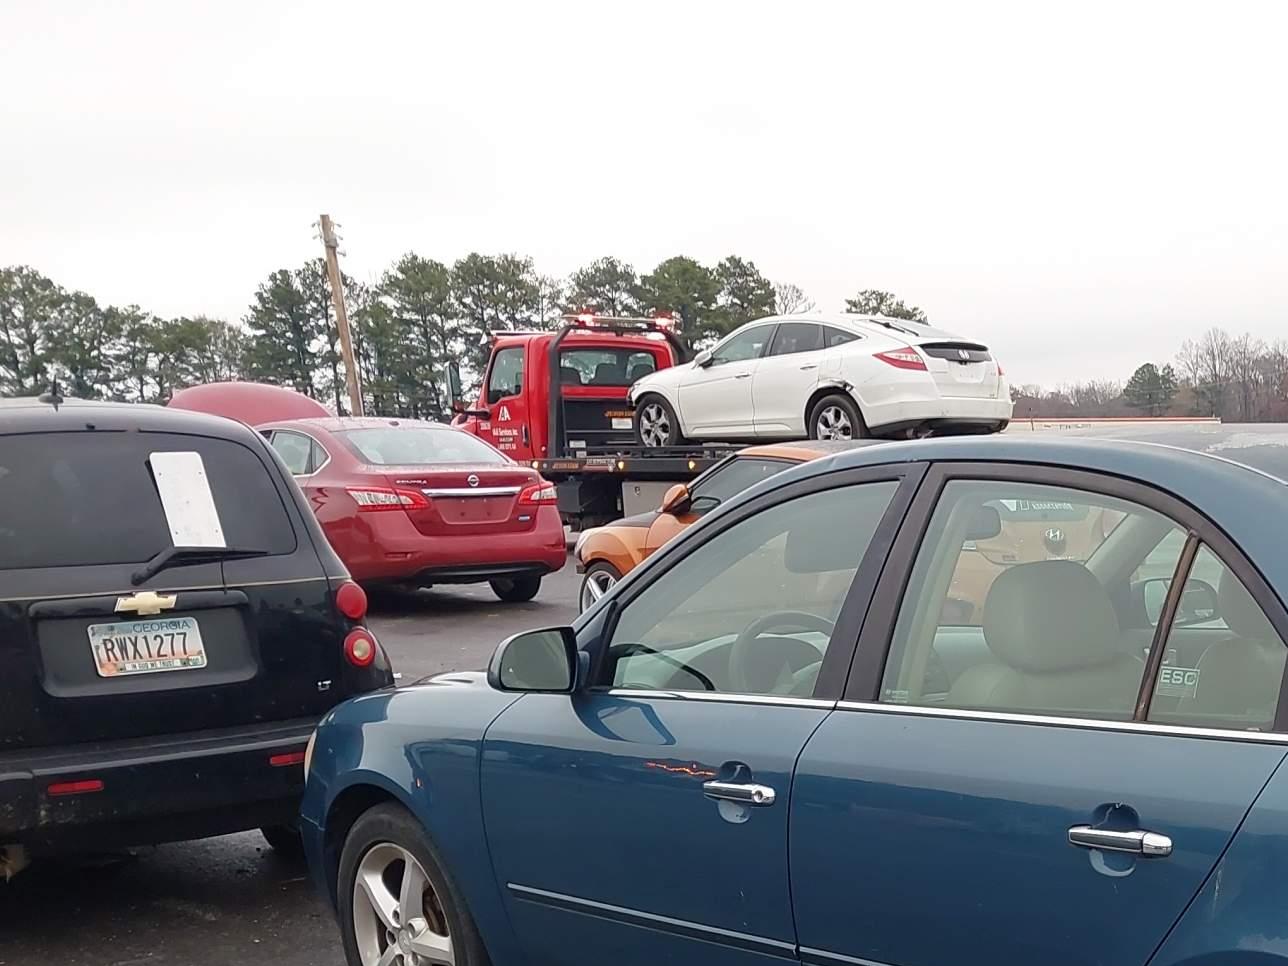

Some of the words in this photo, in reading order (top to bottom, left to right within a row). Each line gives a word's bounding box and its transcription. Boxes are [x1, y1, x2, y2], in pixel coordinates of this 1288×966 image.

[133, 620, 191, 633] GEORGIA
[102, 632, 188, 662] RWX1277
[1160, 669, 1197, 685] ESC
